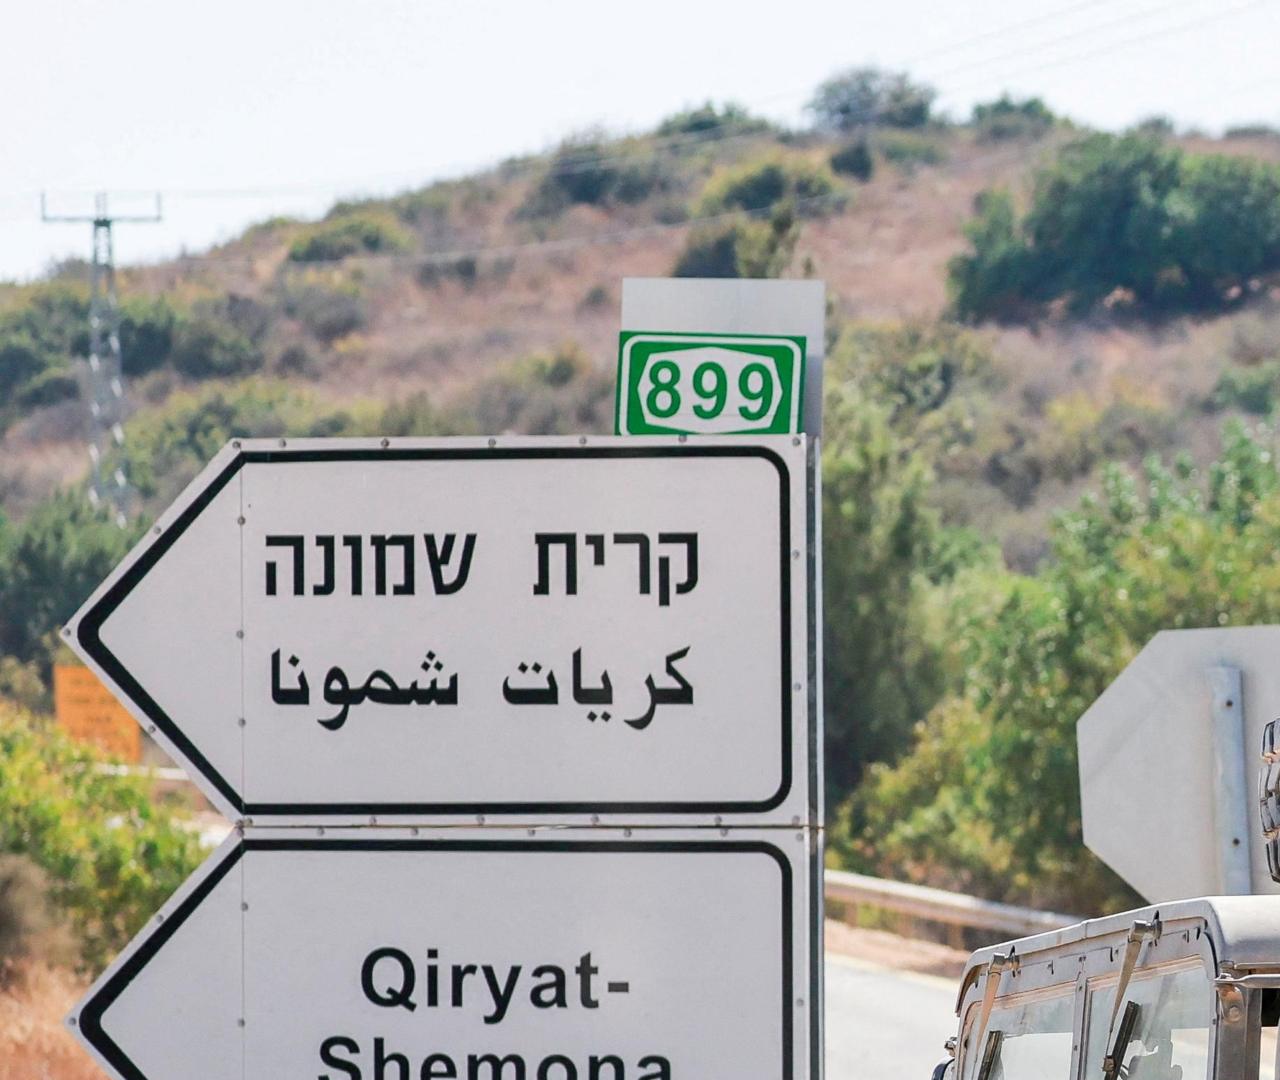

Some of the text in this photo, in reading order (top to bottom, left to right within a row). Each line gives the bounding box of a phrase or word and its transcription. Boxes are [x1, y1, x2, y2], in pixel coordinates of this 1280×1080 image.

[647, 360, 774, 421] 899
[265, 532, 699, 607] קרית שמונה
[271, 646, 694, 731] كريات شمونا
[360, 946, 631, 1025] Qiryat-
